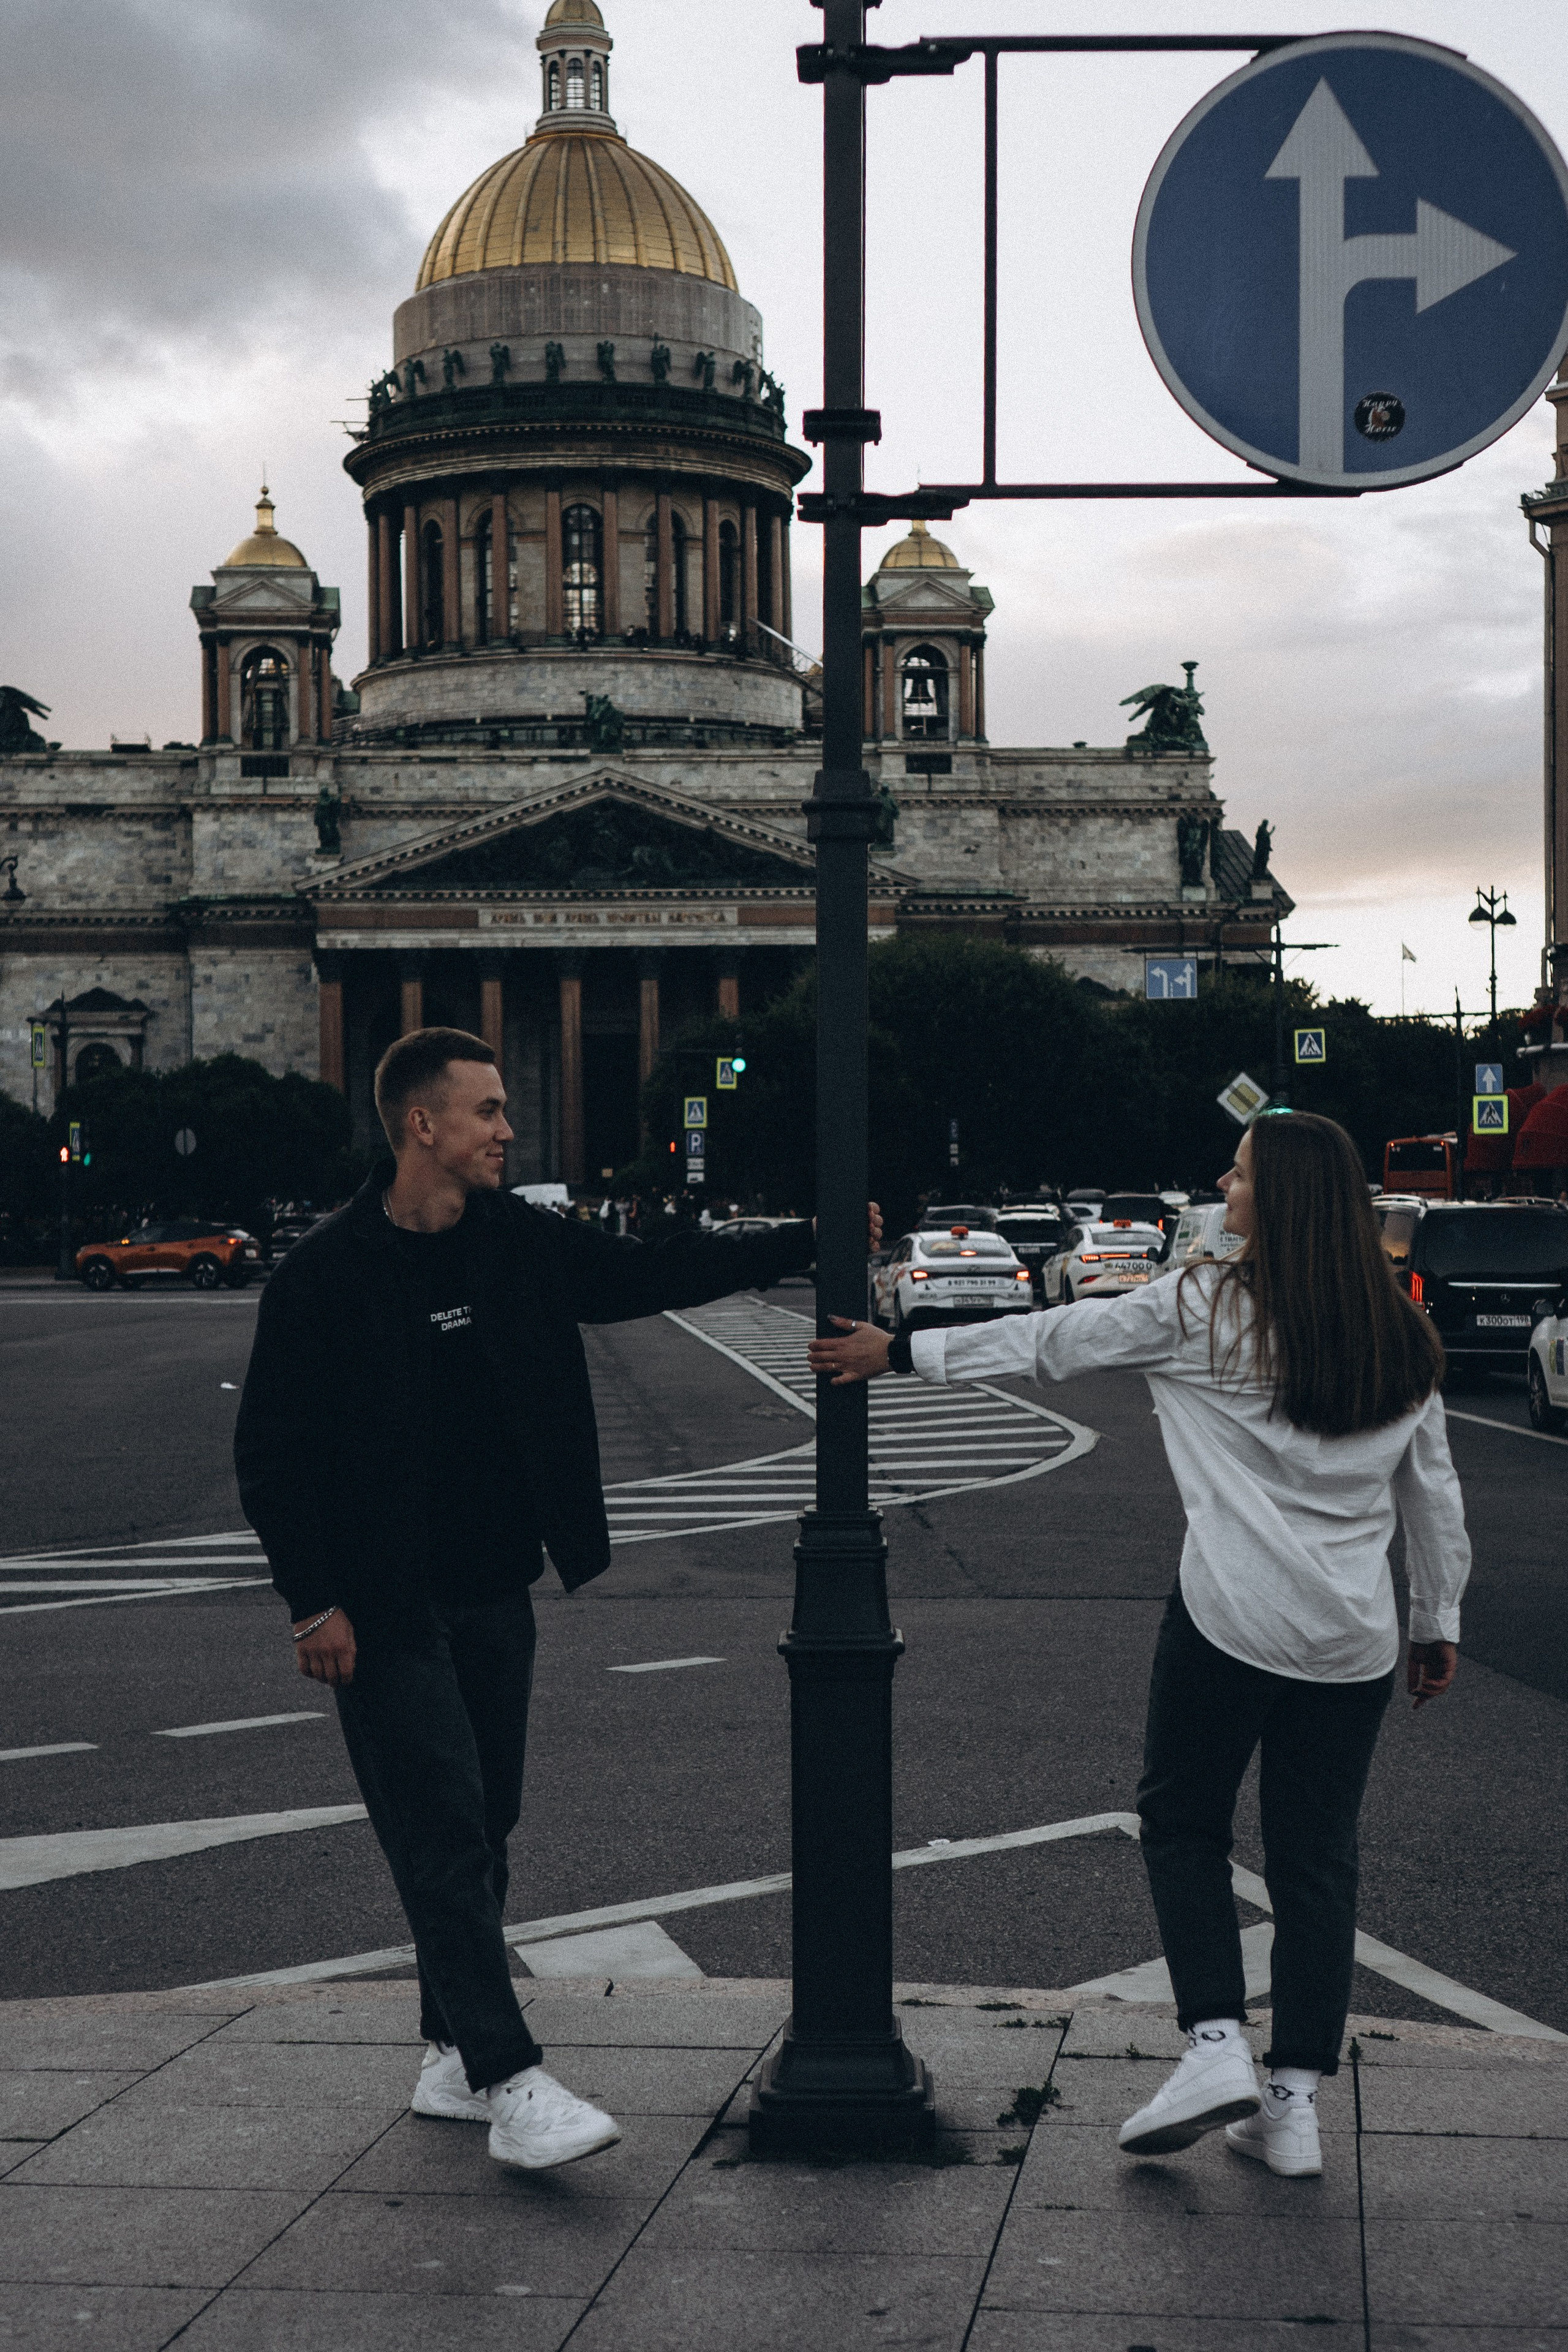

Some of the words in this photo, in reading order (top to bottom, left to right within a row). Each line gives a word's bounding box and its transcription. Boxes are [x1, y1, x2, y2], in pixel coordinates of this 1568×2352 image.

[1363, 399, 1398, 409] Happy
[1365, 424, 1396, 433] Horse
[691, 1134, 701, 1152] P
[431, 1308, 462, 1321] DELETE
[442, 1317, 472, 1330] DRAMA
